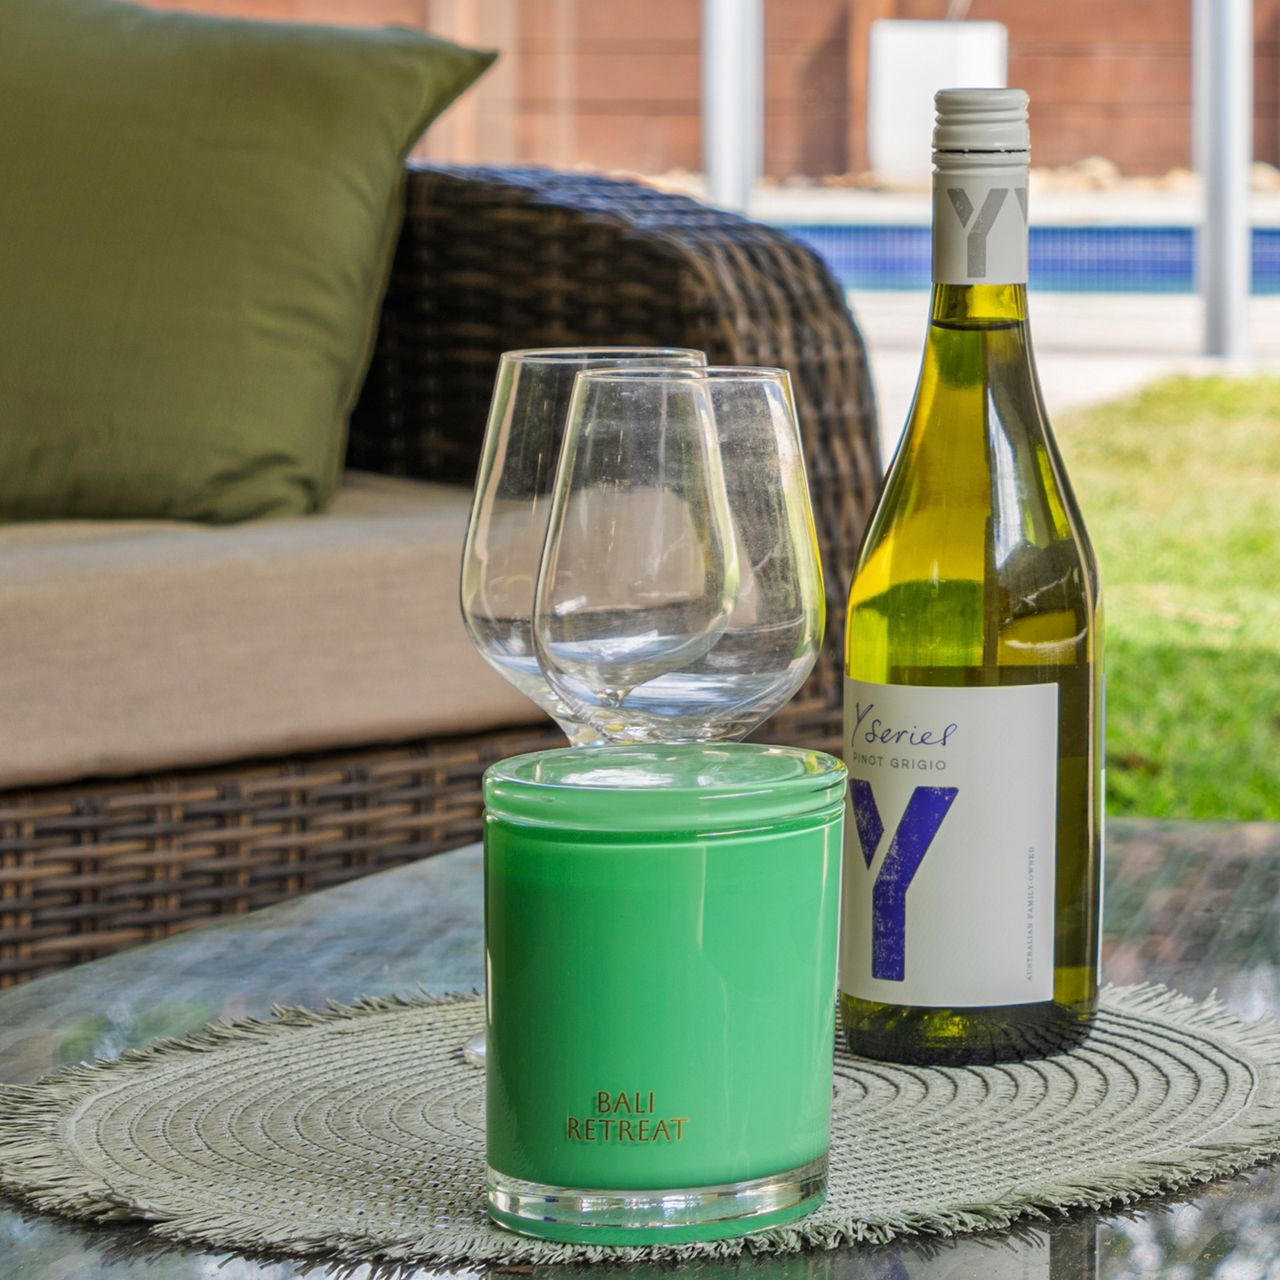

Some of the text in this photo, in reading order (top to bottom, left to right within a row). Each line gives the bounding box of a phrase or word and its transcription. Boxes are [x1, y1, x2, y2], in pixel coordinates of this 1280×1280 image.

[947, 187, 1009, 279] Y
[851, 702, 874, 748] Y
[852, 752, 947, 771] PINOT GRIGIO
[850, 777, 959, 982] Y
[1026, 846, 1035, 982] AUSTRALIAN FAMILY-OWNED
[597, 1090, 655, 1114] BALI
[566, 1116, 689, 1142] RETREAT
